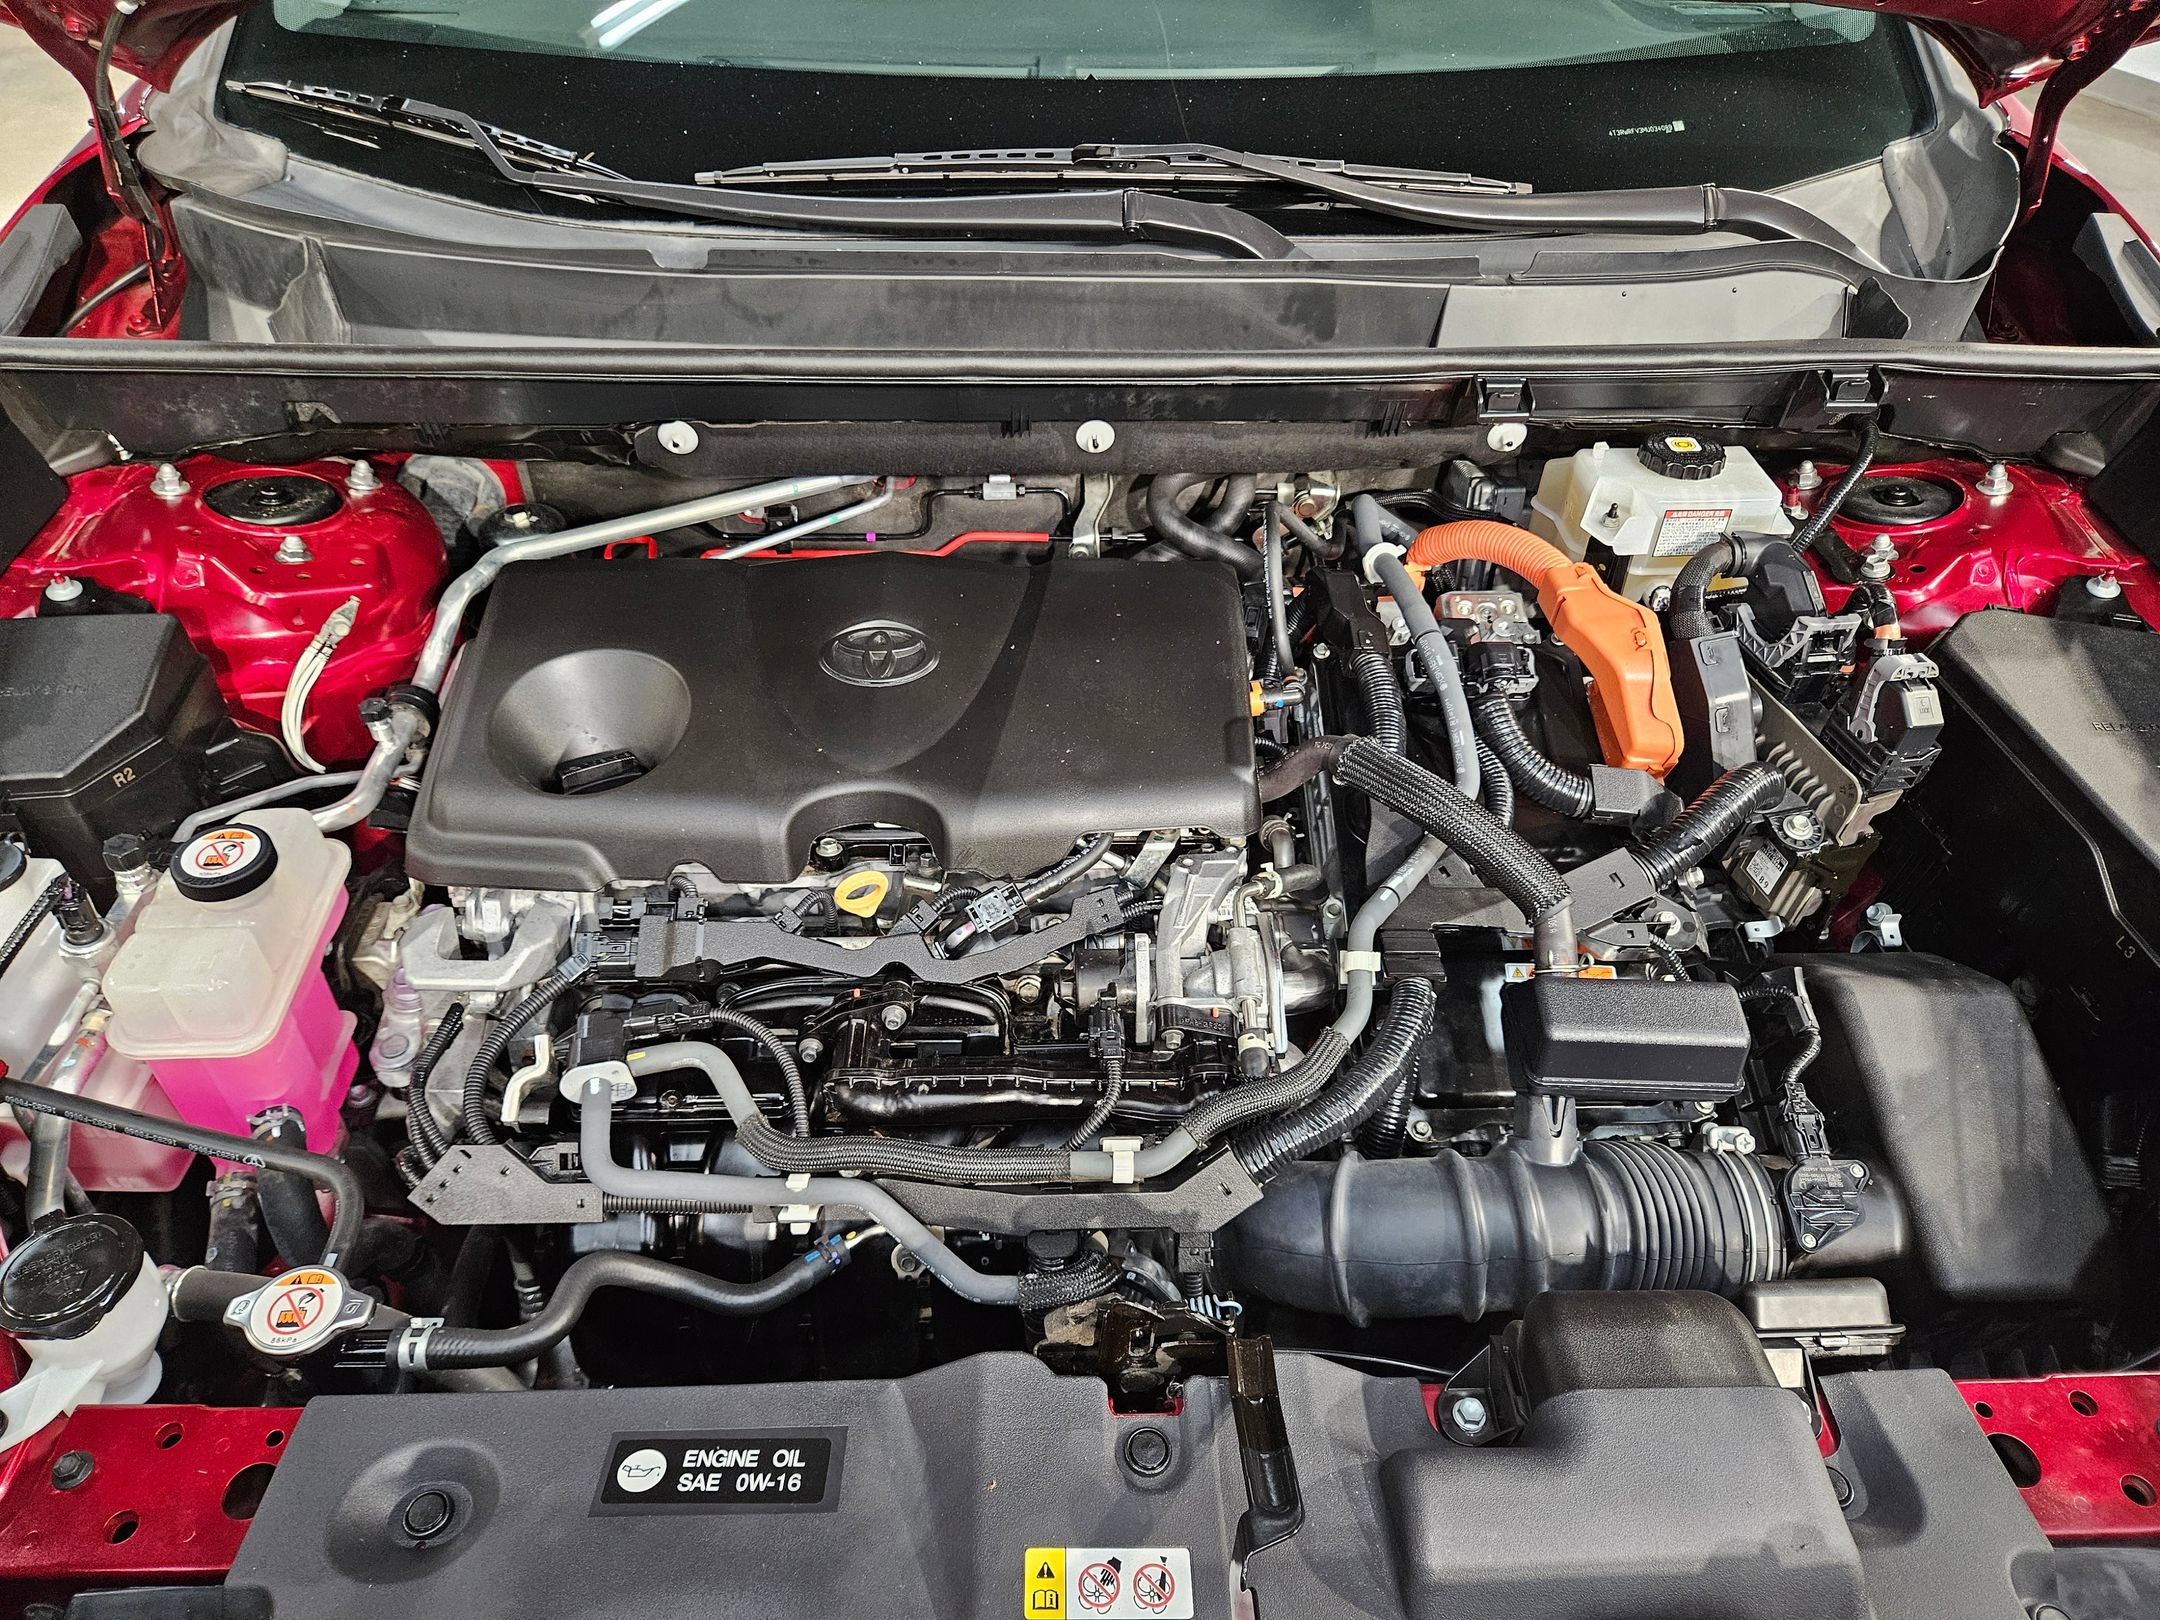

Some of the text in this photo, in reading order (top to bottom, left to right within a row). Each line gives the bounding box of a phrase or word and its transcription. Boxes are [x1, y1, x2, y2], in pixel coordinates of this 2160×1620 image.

[112, 767, 136, 787] R2
[2115, 935, 2136, 958] L3
[682, 1449, 806, 1468] ENGINE OIL
[677, 1473, 802, 1492] SAE 0W-16
